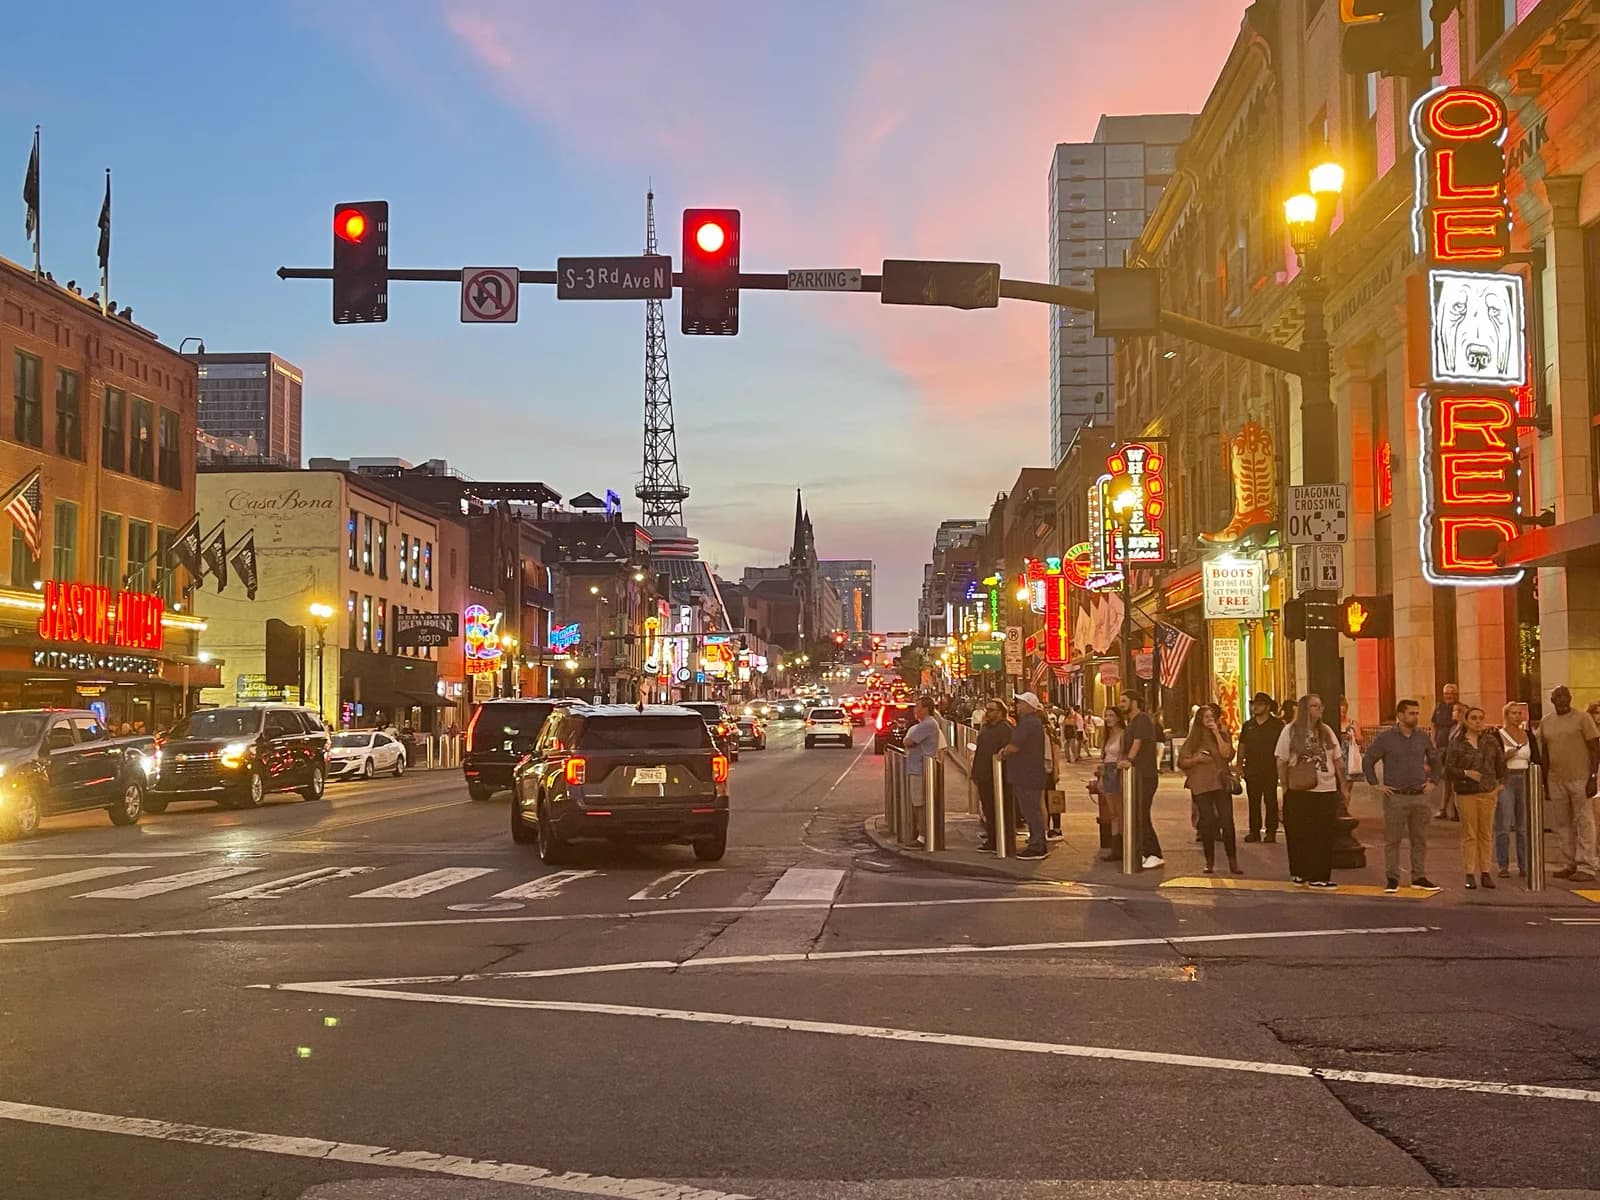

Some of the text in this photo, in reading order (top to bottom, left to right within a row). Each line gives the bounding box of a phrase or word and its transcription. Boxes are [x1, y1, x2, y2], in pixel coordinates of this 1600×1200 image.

[788, 271, 847, 288] PARKING
[1429, 89, 1519, 569] OLE RED
[225, 488, 334, 511] Casa Bona
[1125, 449, 1146, 535] WHISKEY
[1294, 487, 1341, 499] DIAGONAL
[1295, 499, 1341, 511] CROSSING
[1289, 515, 1313, 536] OK
[1212, 568, 1254, 578] BOOTS
[1218, 596, 1249, 606] FREE
[39, 579, 111, 646] JASON
[417, 634, 441, 646] MOJO
[34, 651, 96, 671] KITCHEN
